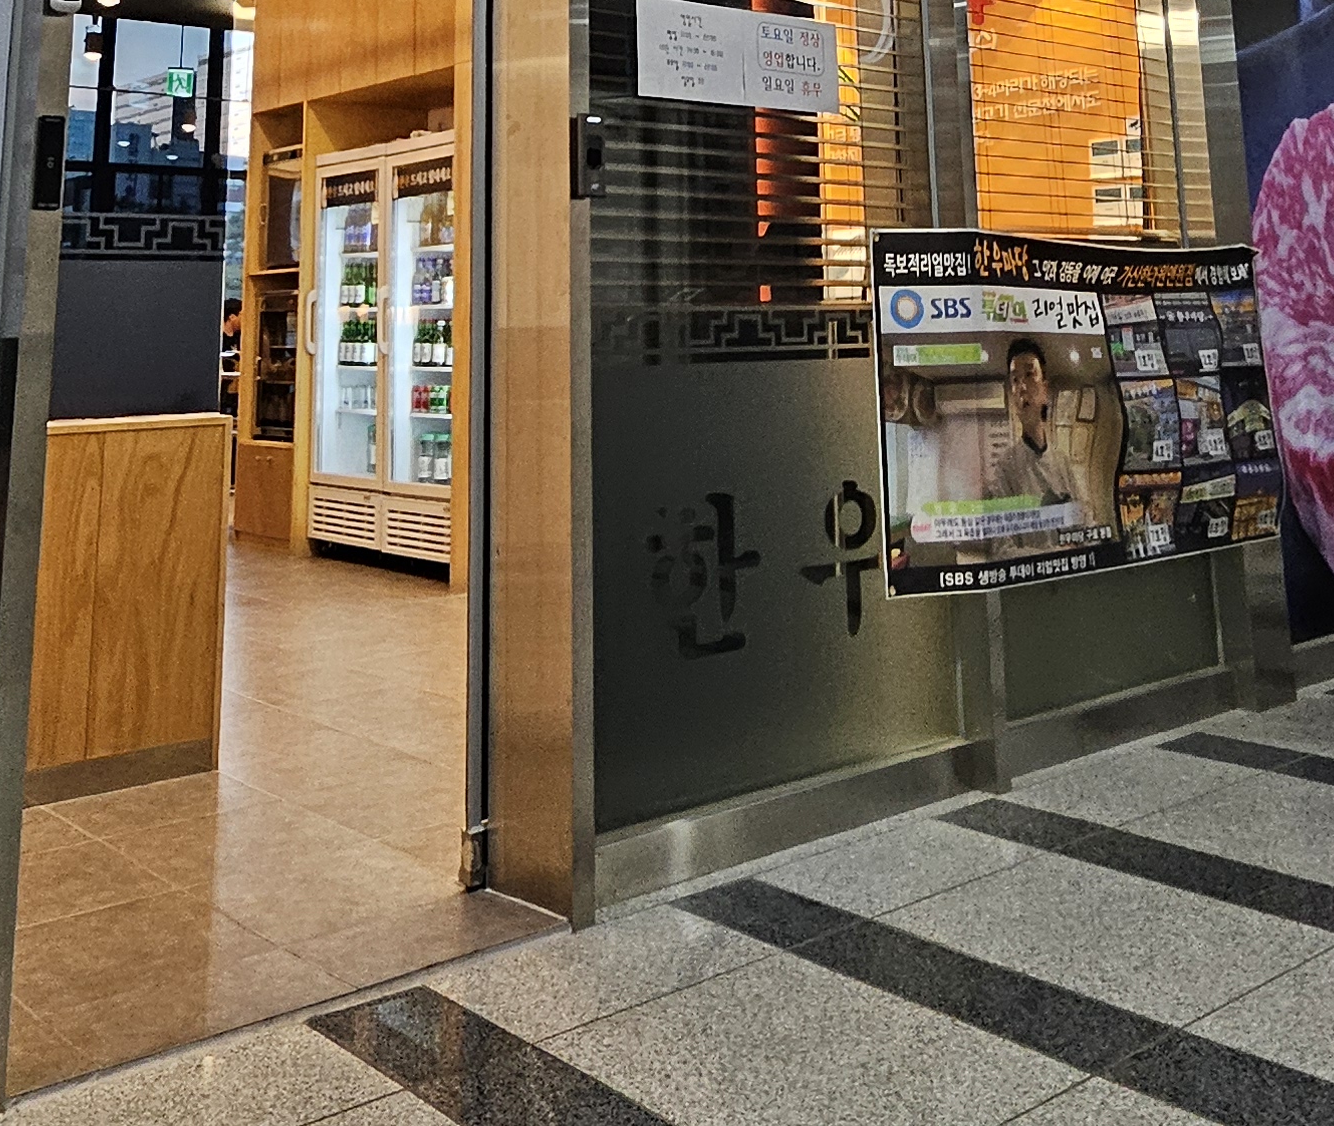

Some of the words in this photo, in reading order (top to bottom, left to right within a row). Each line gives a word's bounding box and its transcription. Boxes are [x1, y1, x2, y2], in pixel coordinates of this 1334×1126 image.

[760, 26, 794, 44] 토요일
[799, 32, 820, 48] 정상
[762, 51, 821, 72] 영업합니다.
[762, 76, 794, 93] 일요일
[801, 81, 822, 97] 휴무
[973, 237, 1029, 281] 한우마당
[930, 298, 972, 319] SBS
